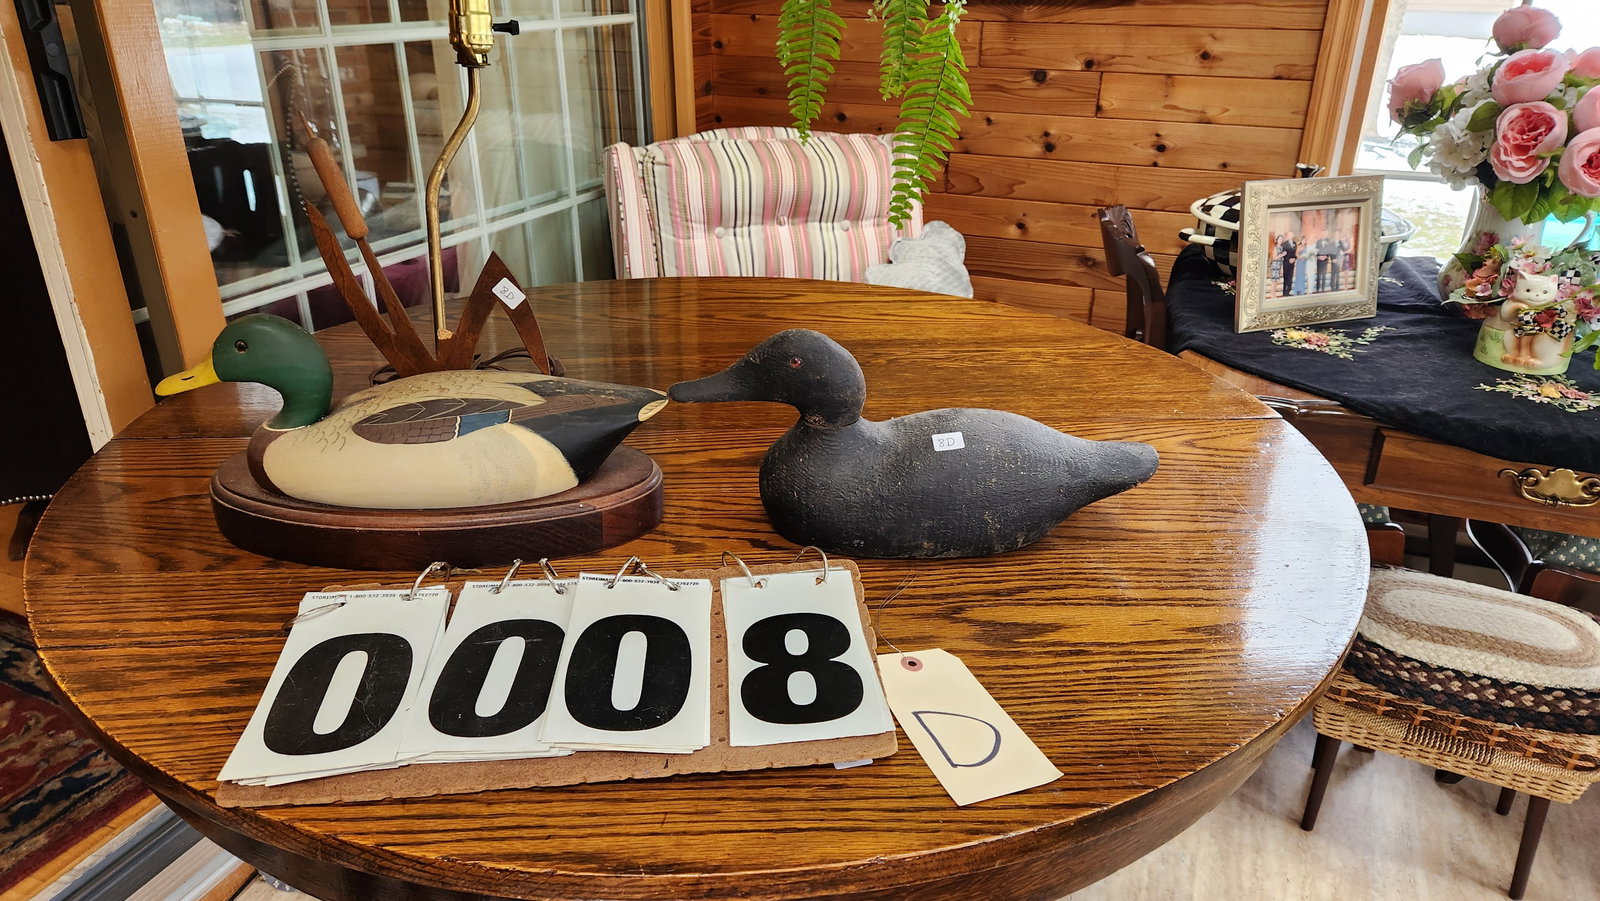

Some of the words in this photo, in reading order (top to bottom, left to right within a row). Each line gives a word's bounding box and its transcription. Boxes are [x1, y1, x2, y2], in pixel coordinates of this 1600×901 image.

[500, 285, 515, 300] 8D
[938, 437, 955, 448] 8D
[911, 710, 1002, 768] D
